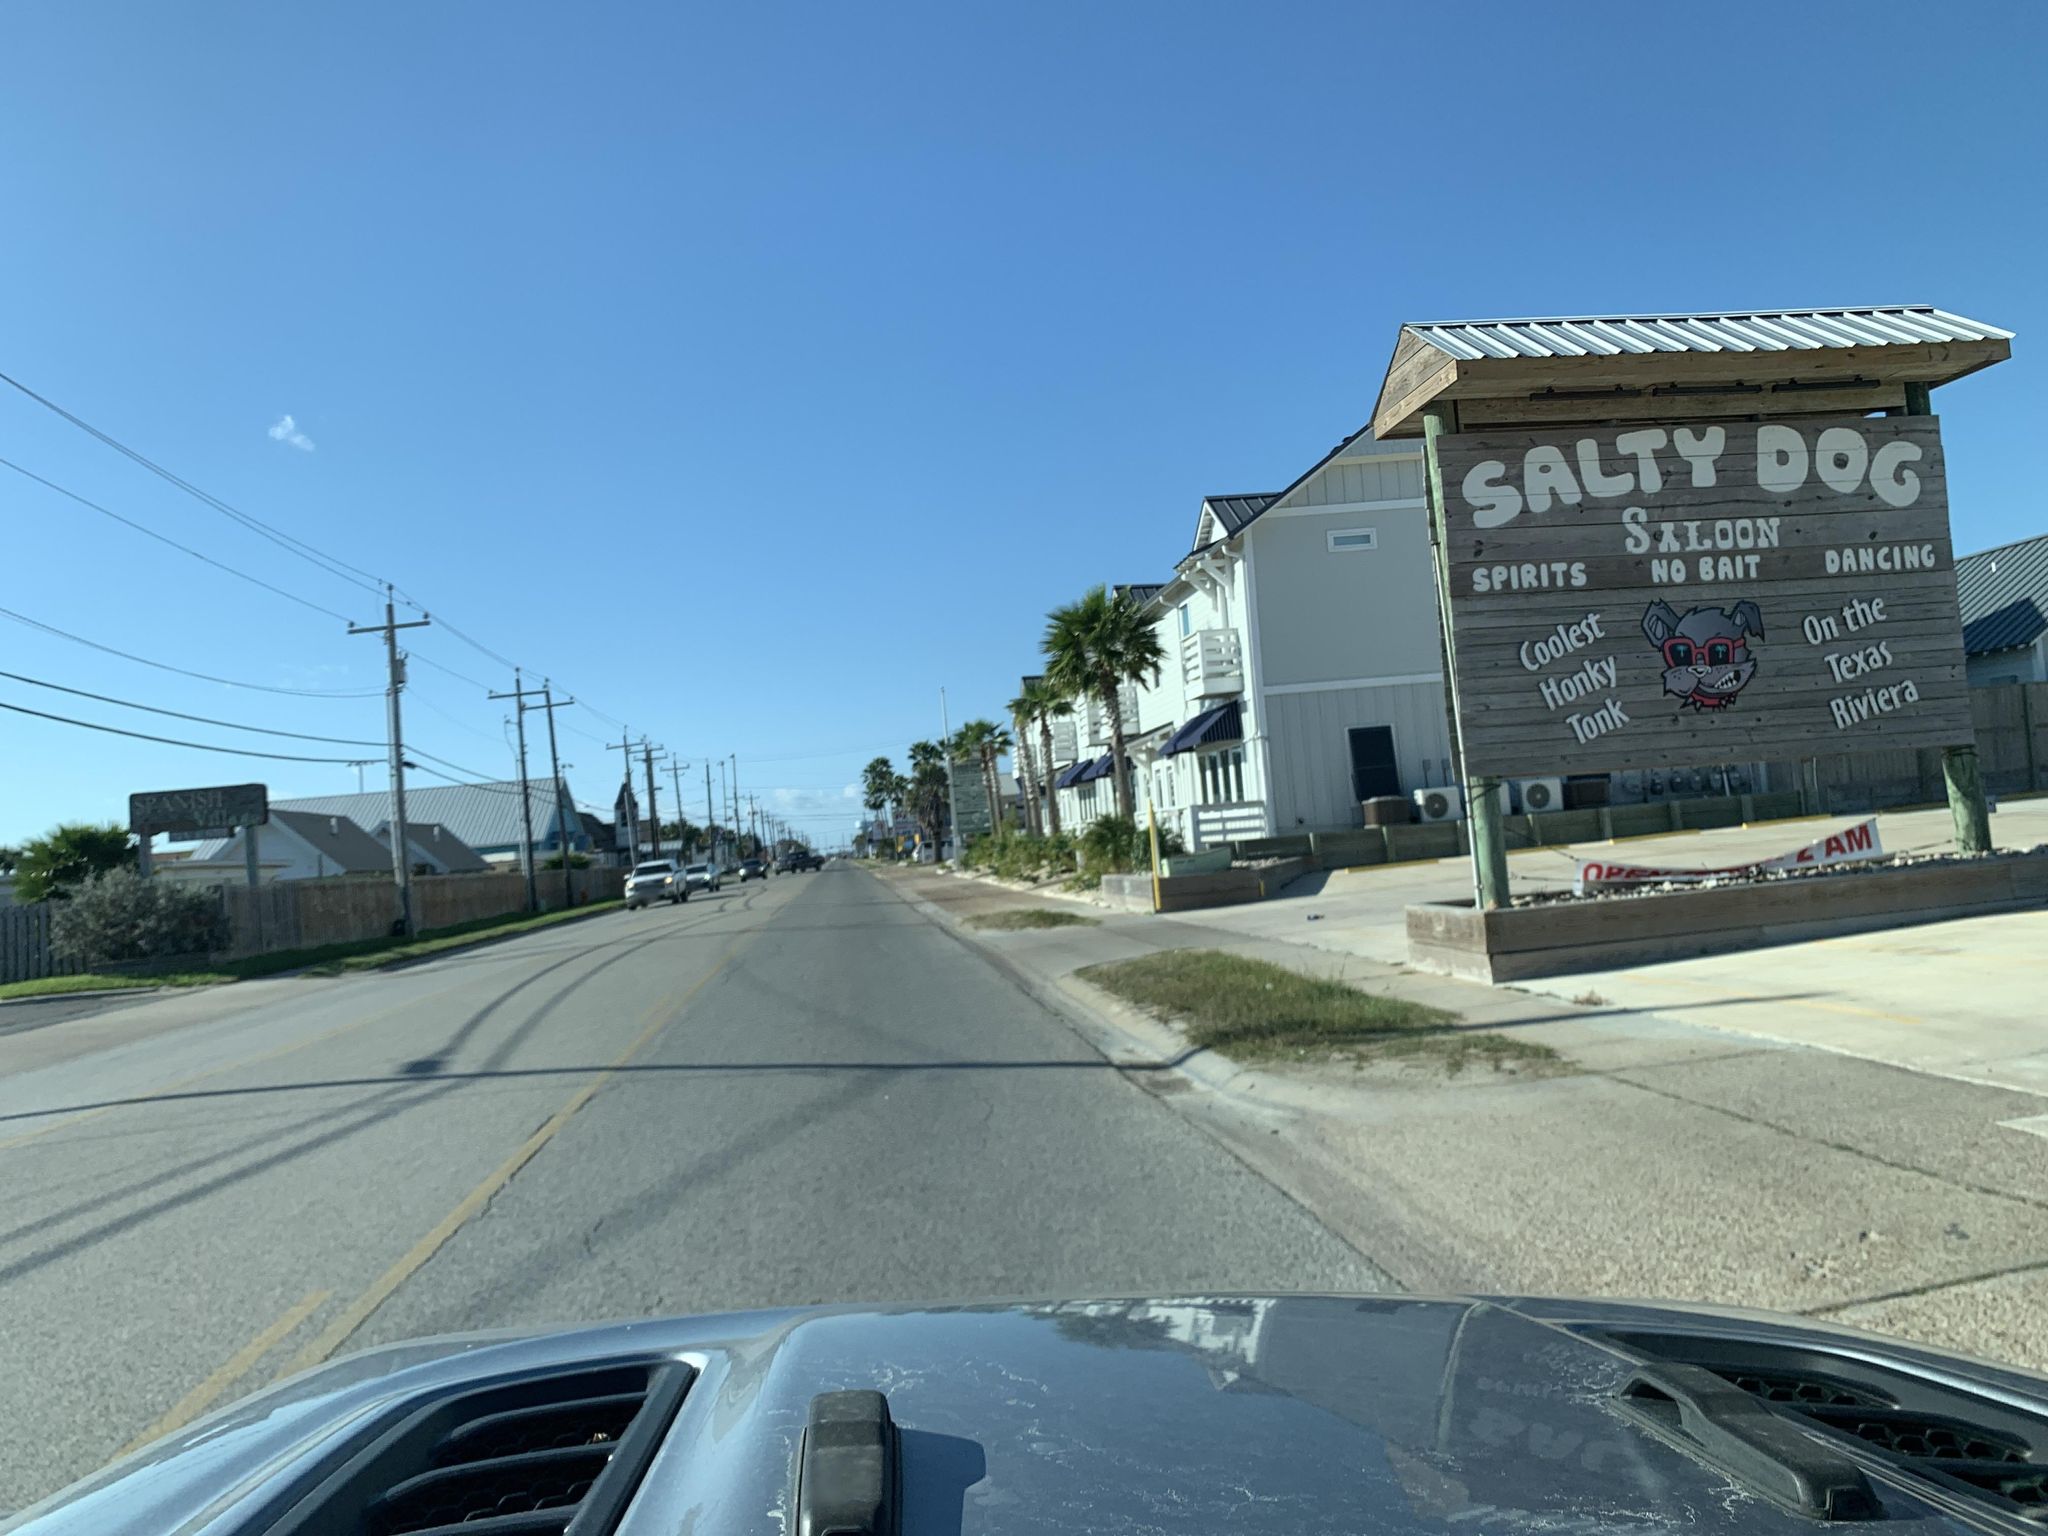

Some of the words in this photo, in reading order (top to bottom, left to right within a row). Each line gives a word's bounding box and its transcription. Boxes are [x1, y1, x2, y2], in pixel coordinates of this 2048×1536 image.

[1462, 425, 1725, 528] SALTY
[1757, 425, 1923, 507] DOG
[1472, 562, 1587, 592] SPIRITS
[1651, 559, 1686, 584] NO
[1700, 555, 1761, 581] BAIT
[1825, 544, 1936, 574] DANCING
[1519, 612, 1606, 672] Coolest
[1803, 613, 1839, 646] On
[1843, 597, 1887, 633] the
[1538, 654, 1618, 711] Honky
[1824, 640, 1893, 684] Texas
[1566, 699, 1630, 745] Tonk
[1829, 679, 1919, 730] Riviera
[1824, 824, 1872, 858] AM
